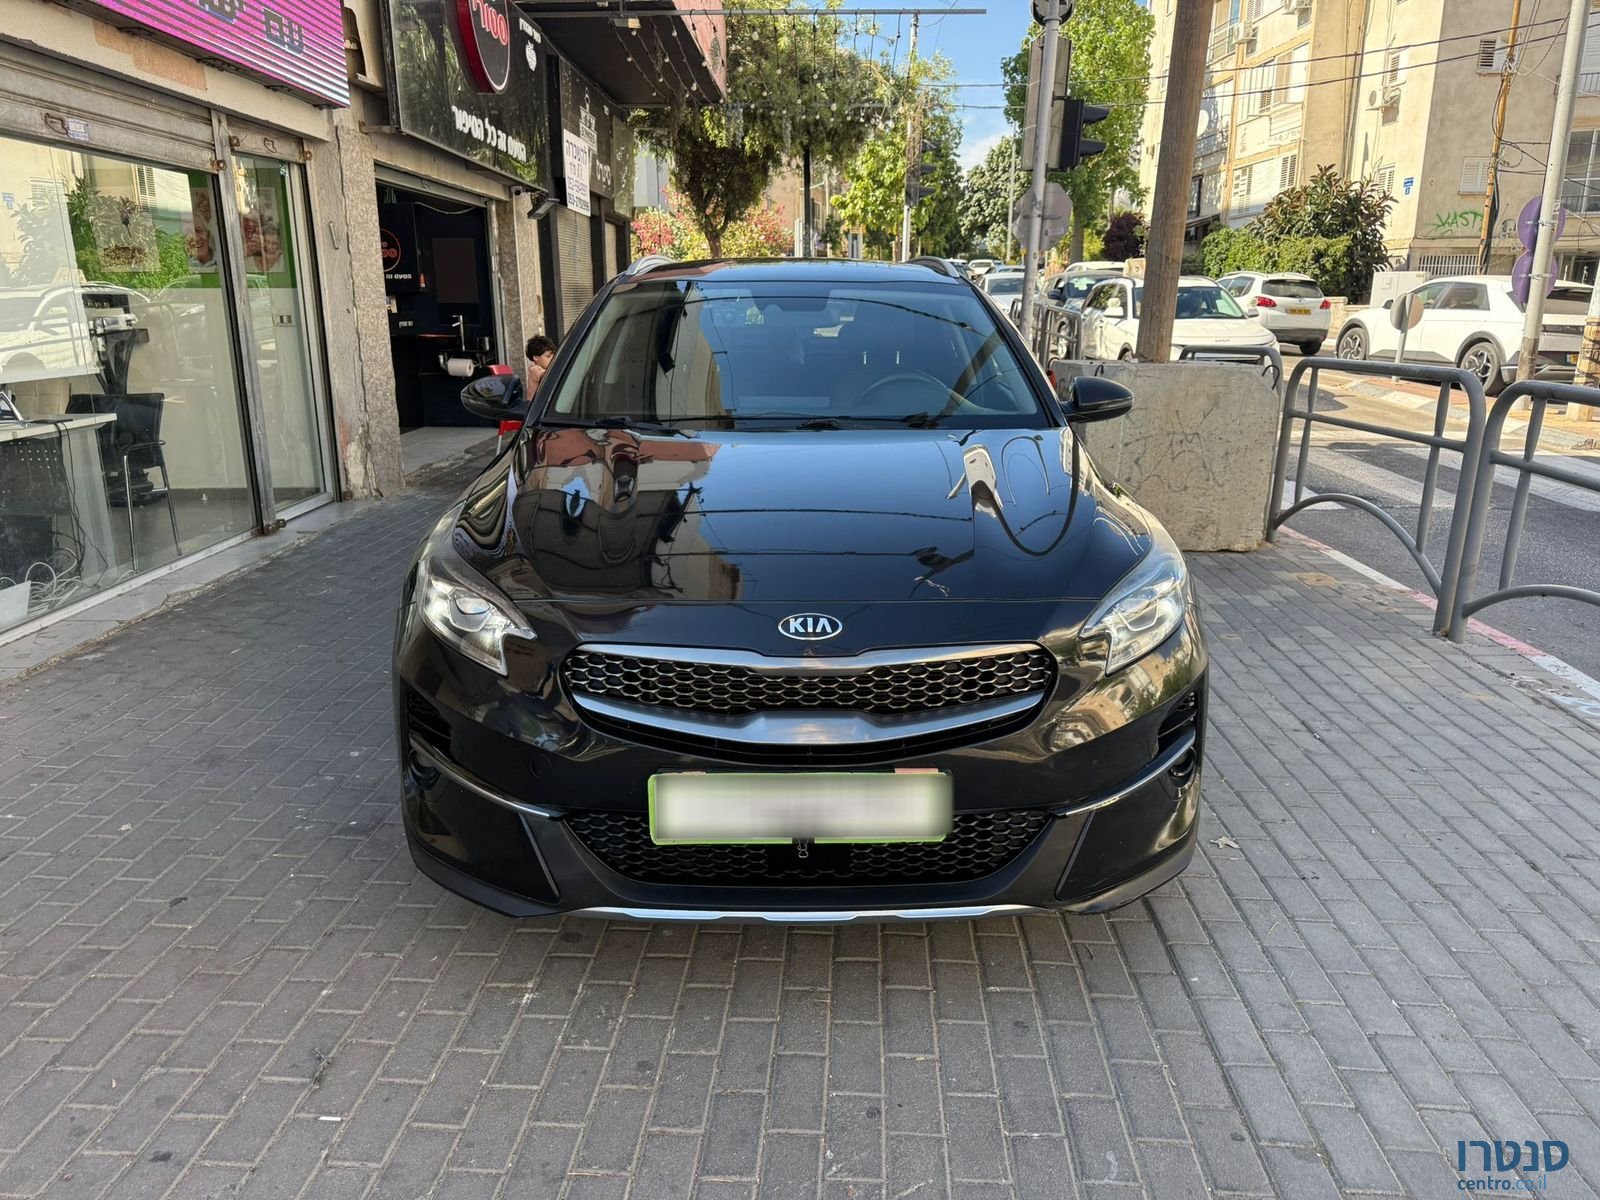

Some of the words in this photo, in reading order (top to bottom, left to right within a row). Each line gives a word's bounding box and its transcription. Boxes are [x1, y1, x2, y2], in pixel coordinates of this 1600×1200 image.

[451, 104, 485, 142] הסיפור
[484, 117, 497, 147] כל
[789, 617, 832, 633] KIA
